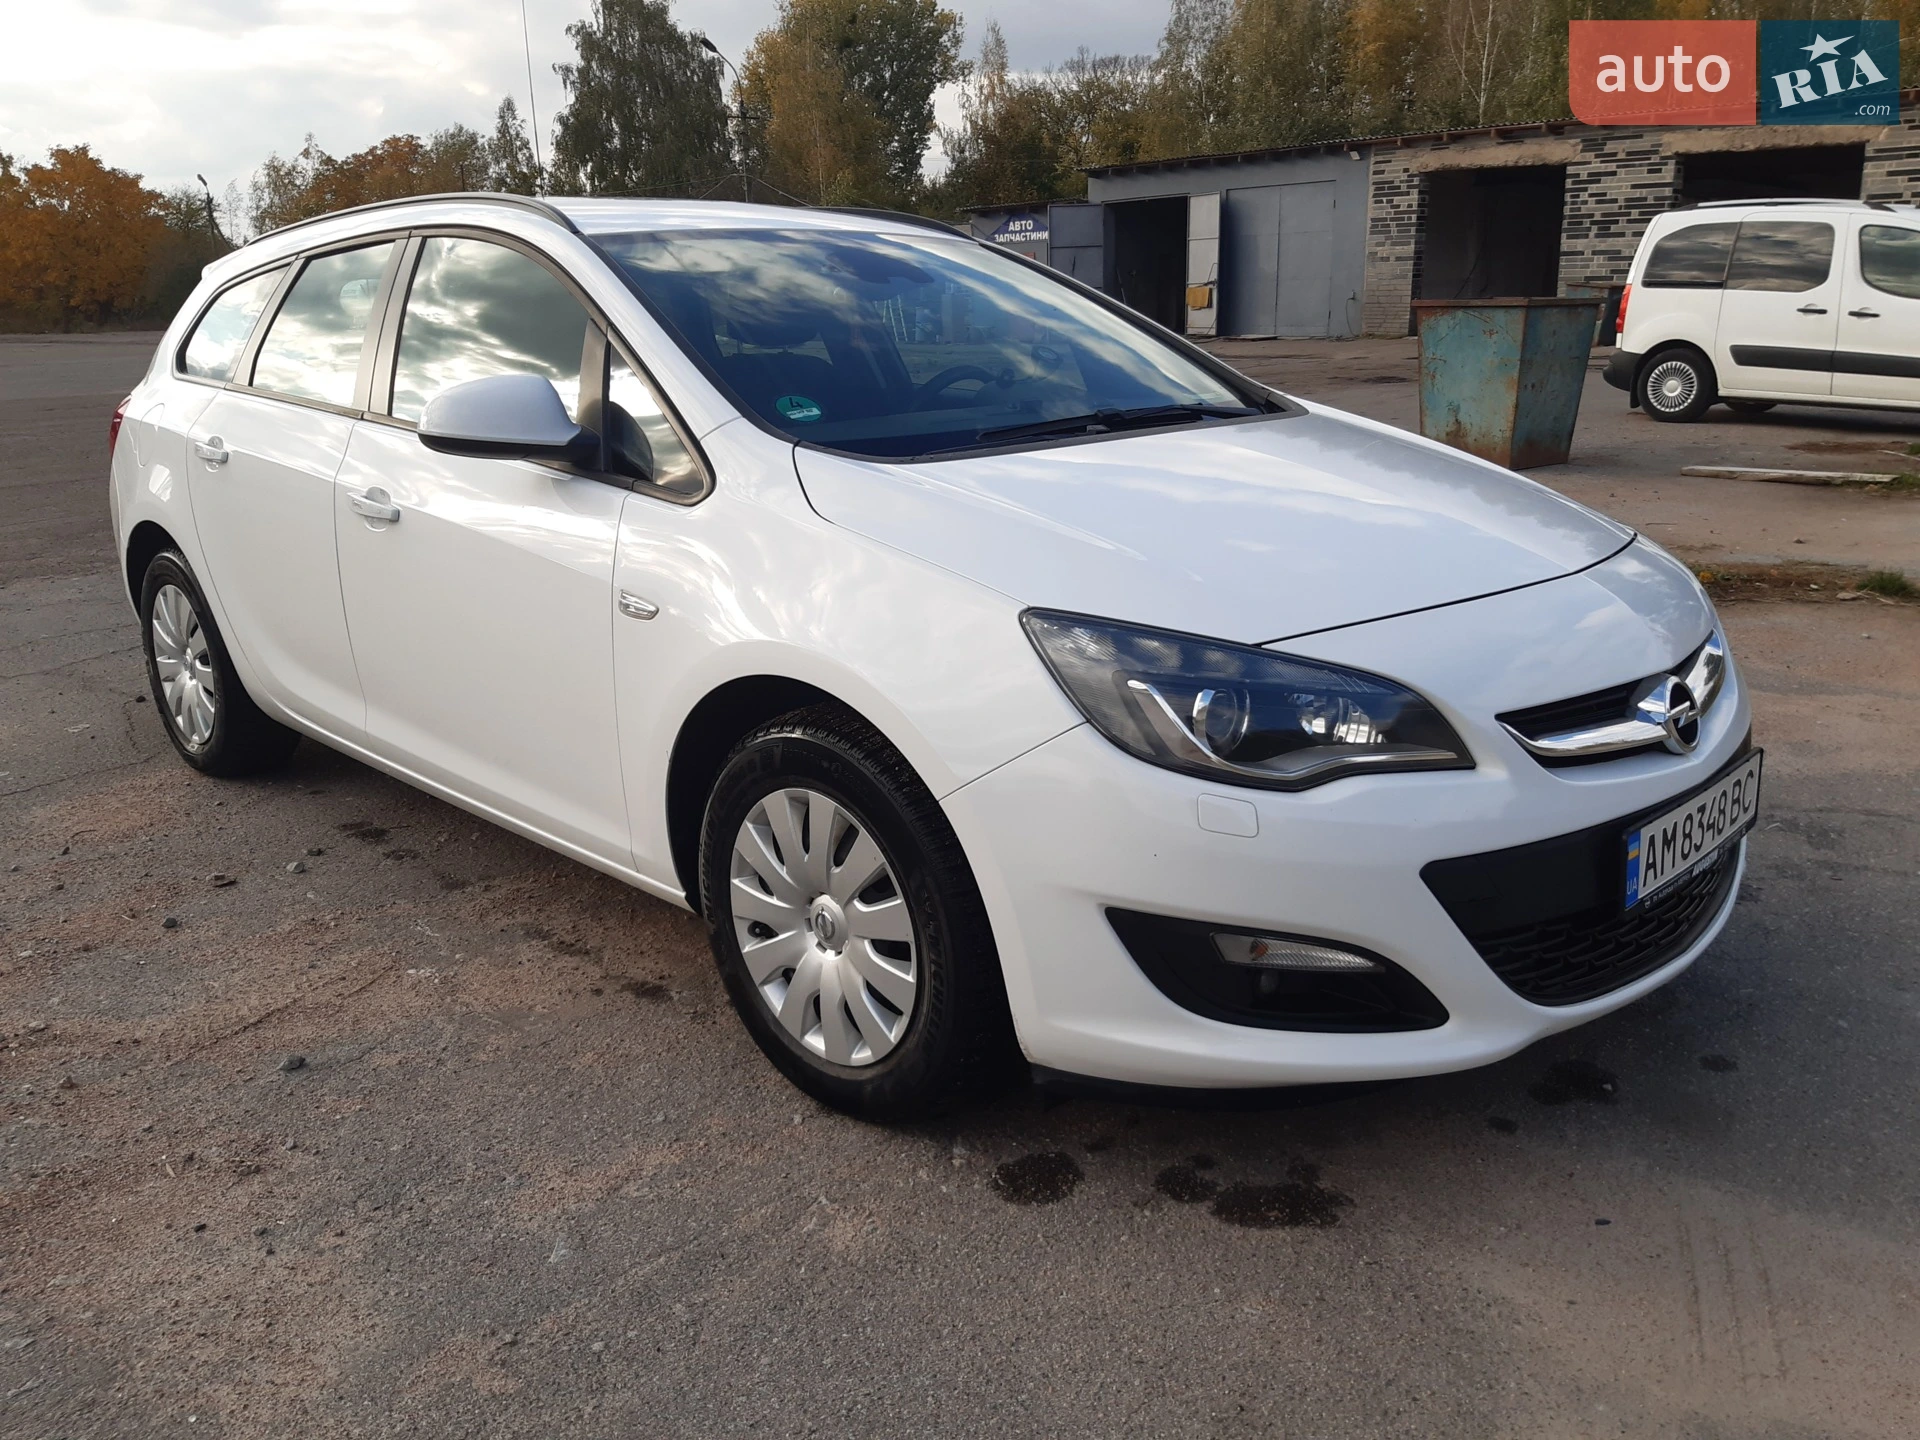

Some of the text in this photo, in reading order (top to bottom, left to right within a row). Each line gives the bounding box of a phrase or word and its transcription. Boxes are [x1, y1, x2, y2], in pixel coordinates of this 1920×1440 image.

[1008, 220, 1033, 231] АВТО
[994, 231, 1048, 242] ЗАПЧАСТИНИ
[1626, 876, 1638, 896] UA
